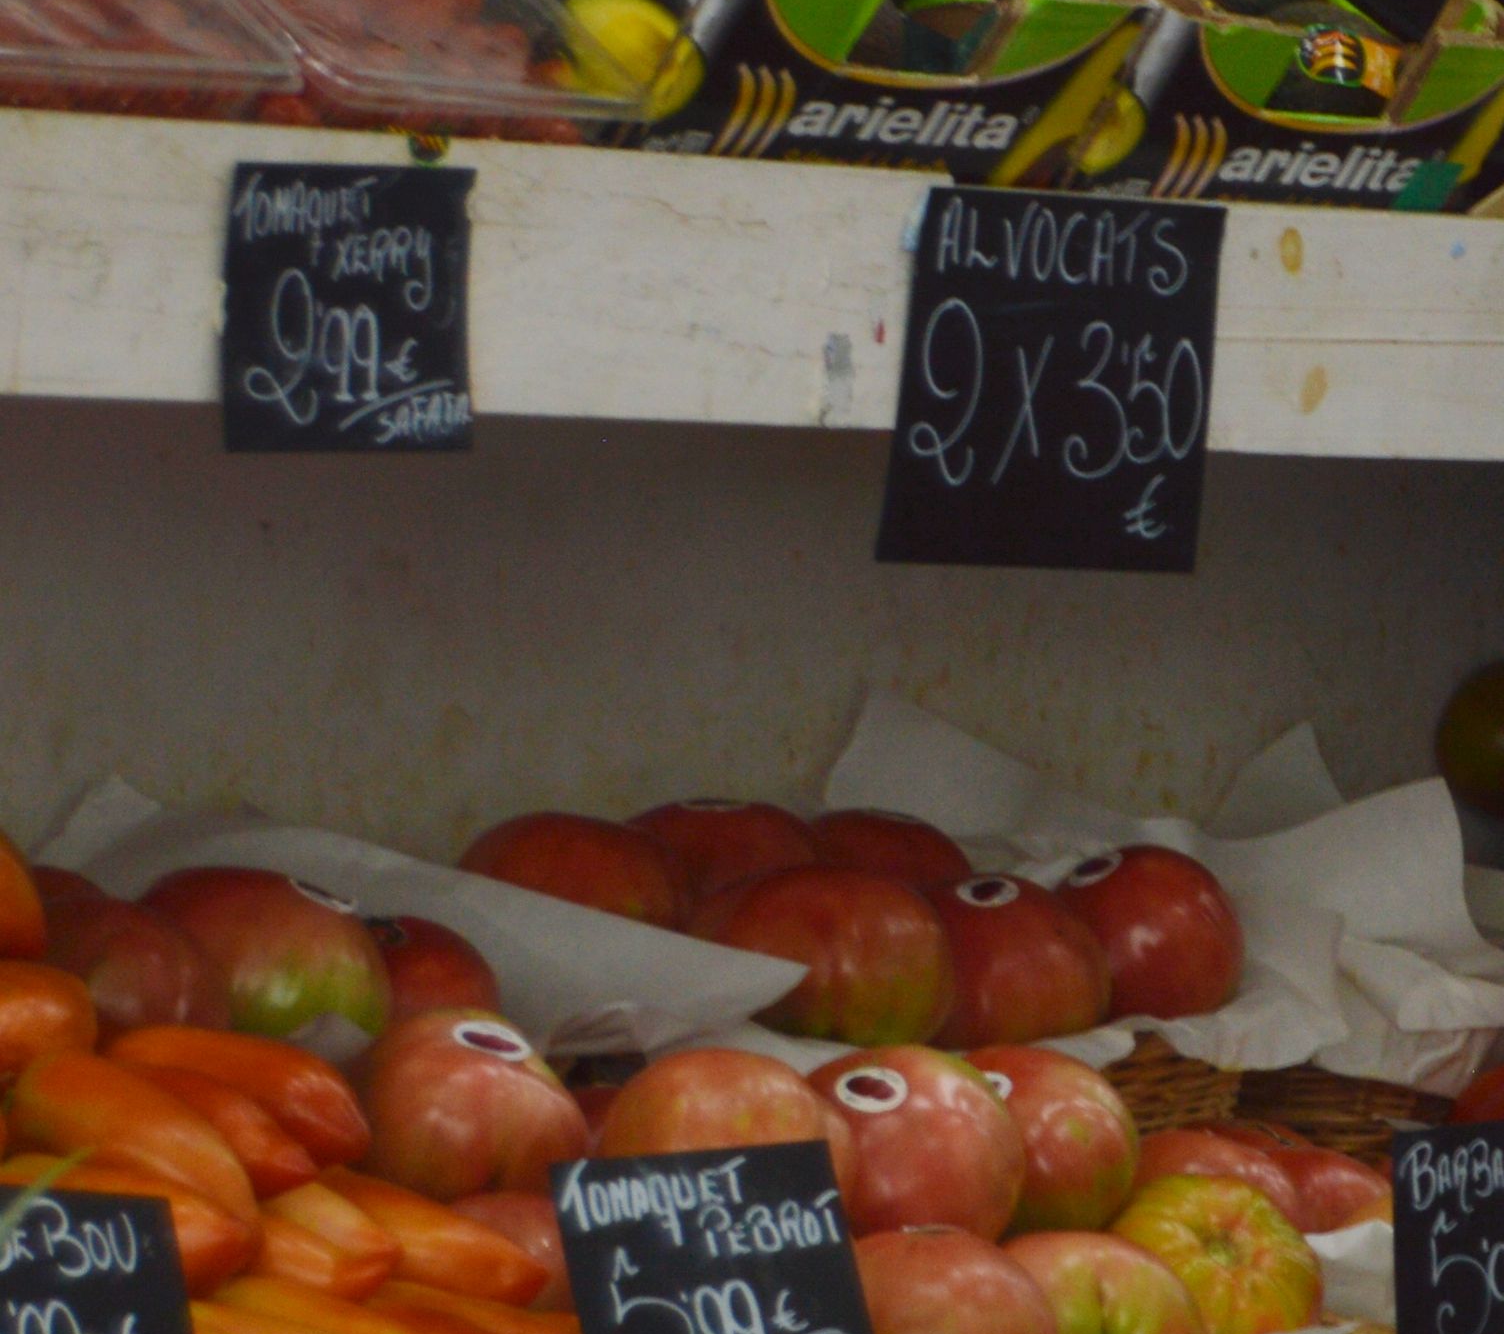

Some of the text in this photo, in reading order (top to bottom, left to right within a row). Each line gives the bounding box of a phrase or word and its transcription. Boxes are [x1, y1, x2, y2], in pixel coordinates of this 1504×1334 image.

[788, 97, 1019, 151] arielita
[909, 297, 984, 487] 2
[1124, 473, 1167, 539] €
[770, 1287, 809, 1333] €
